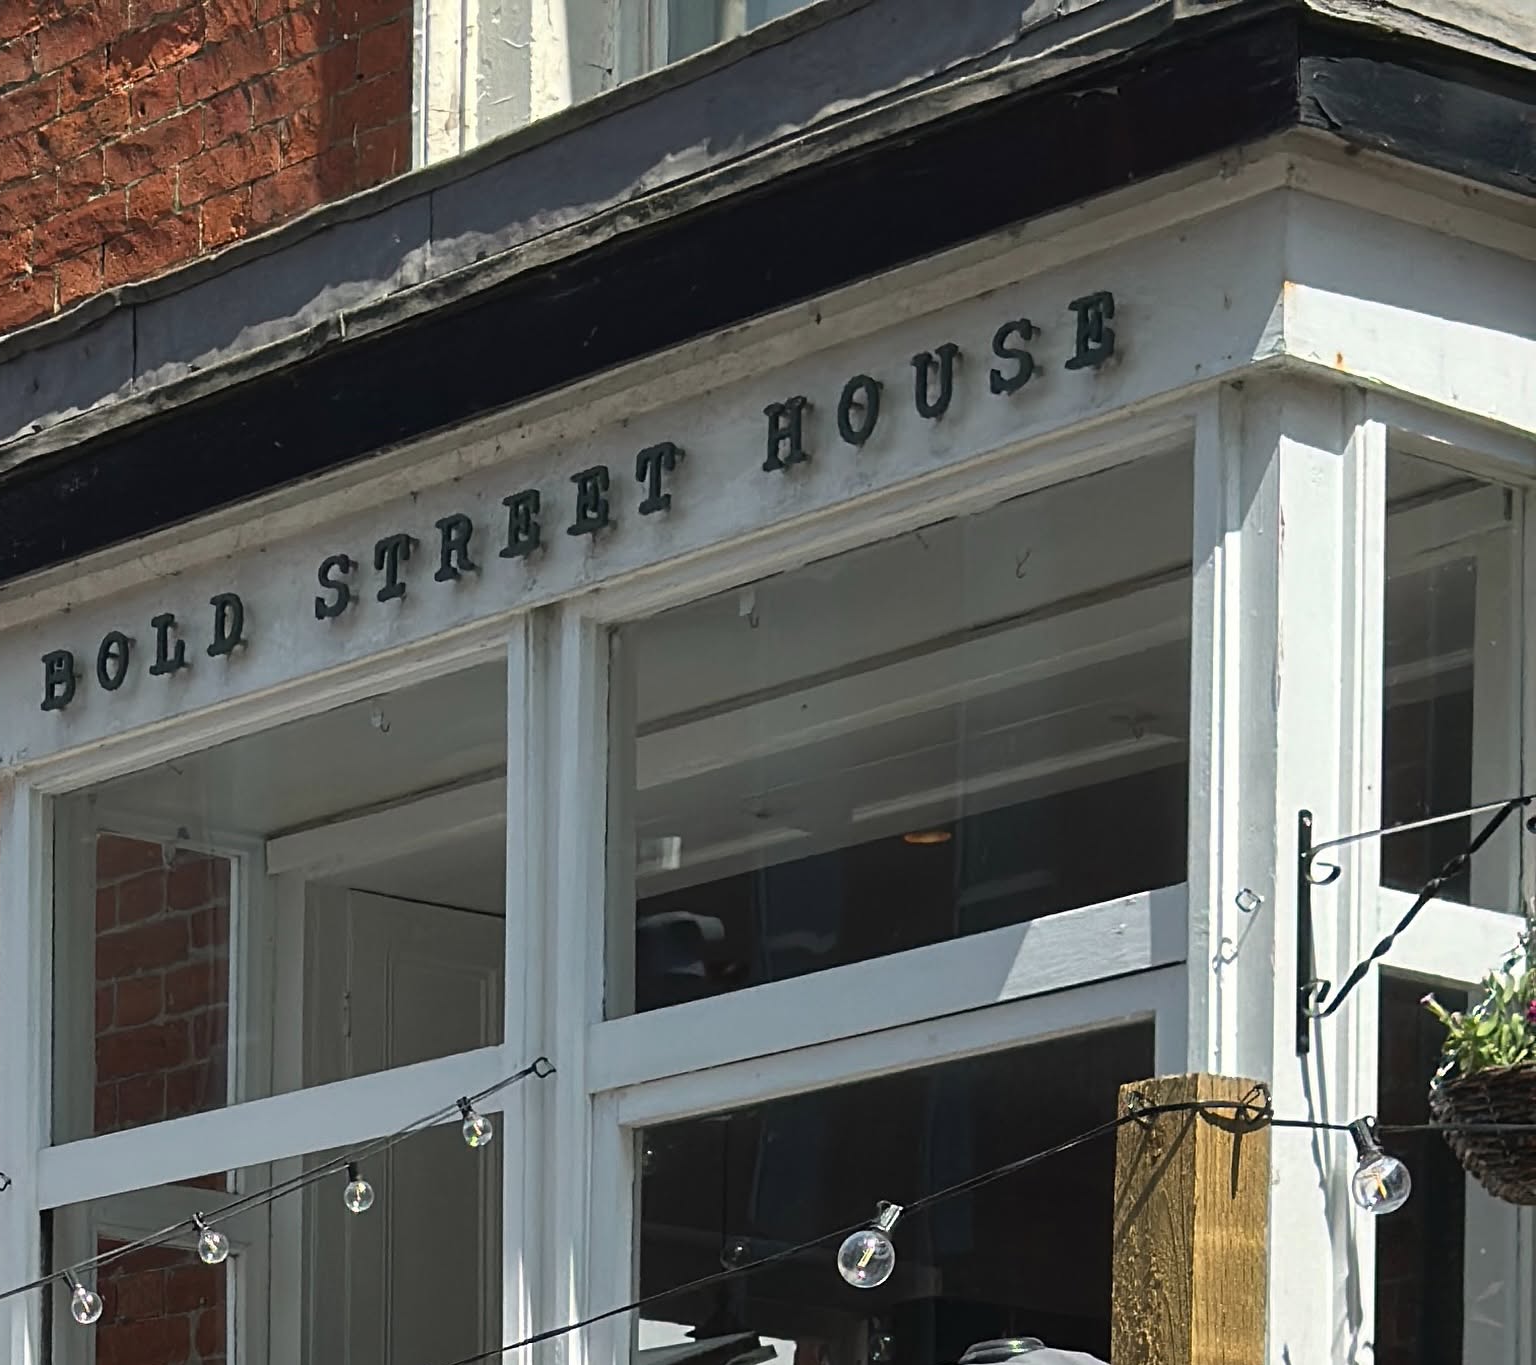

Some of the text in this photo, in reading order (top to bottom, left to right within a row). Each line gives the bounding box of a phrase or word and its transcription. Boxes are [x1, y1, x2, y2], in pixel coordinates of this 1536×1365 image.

[40, 289, 1120, 712] BOLD STREET HOUSE
